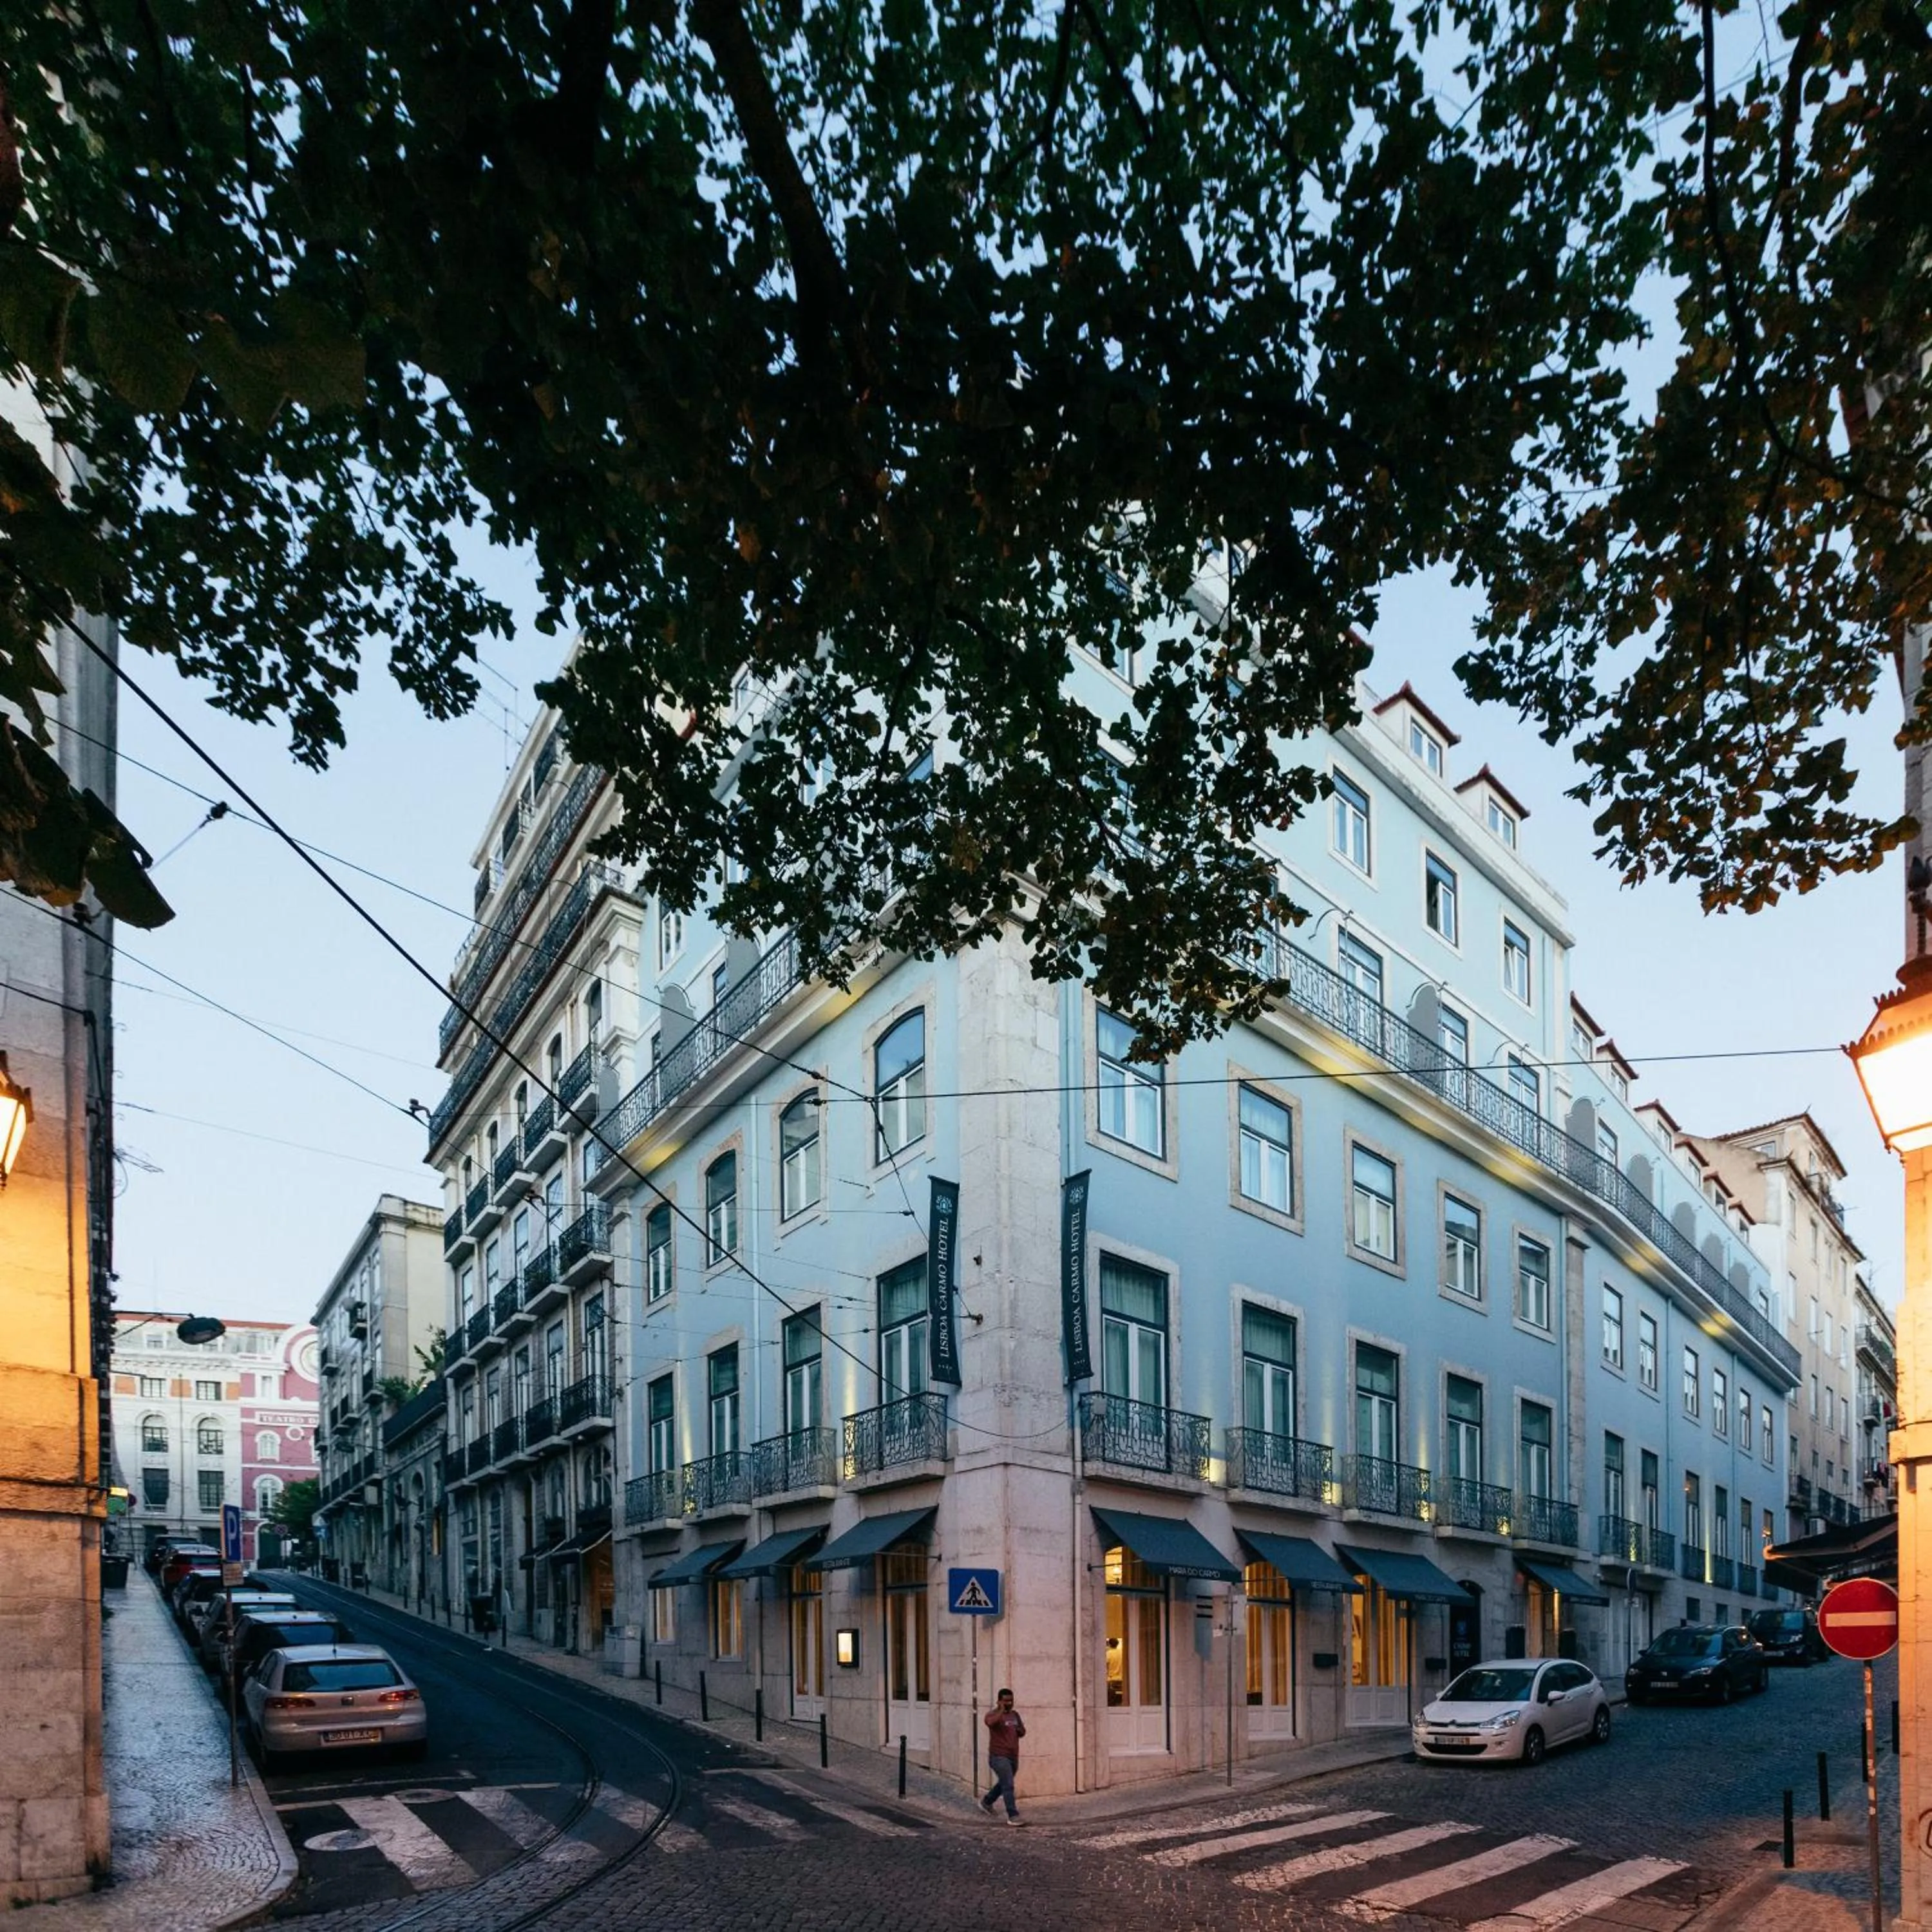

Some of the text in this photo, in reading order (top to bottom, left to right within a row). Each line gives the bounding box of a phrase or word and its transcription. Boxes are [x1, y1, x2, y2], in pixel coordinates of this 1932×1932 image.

[938, 1218, 949, 1358] LISBOA CARMO HOTEL
[1071, 1208, 1083, 1352] LISBOA CARMO HOTEL
[261, 1415, 304, 1423] TEATRO
[226, 1510, 237, 1557] P
